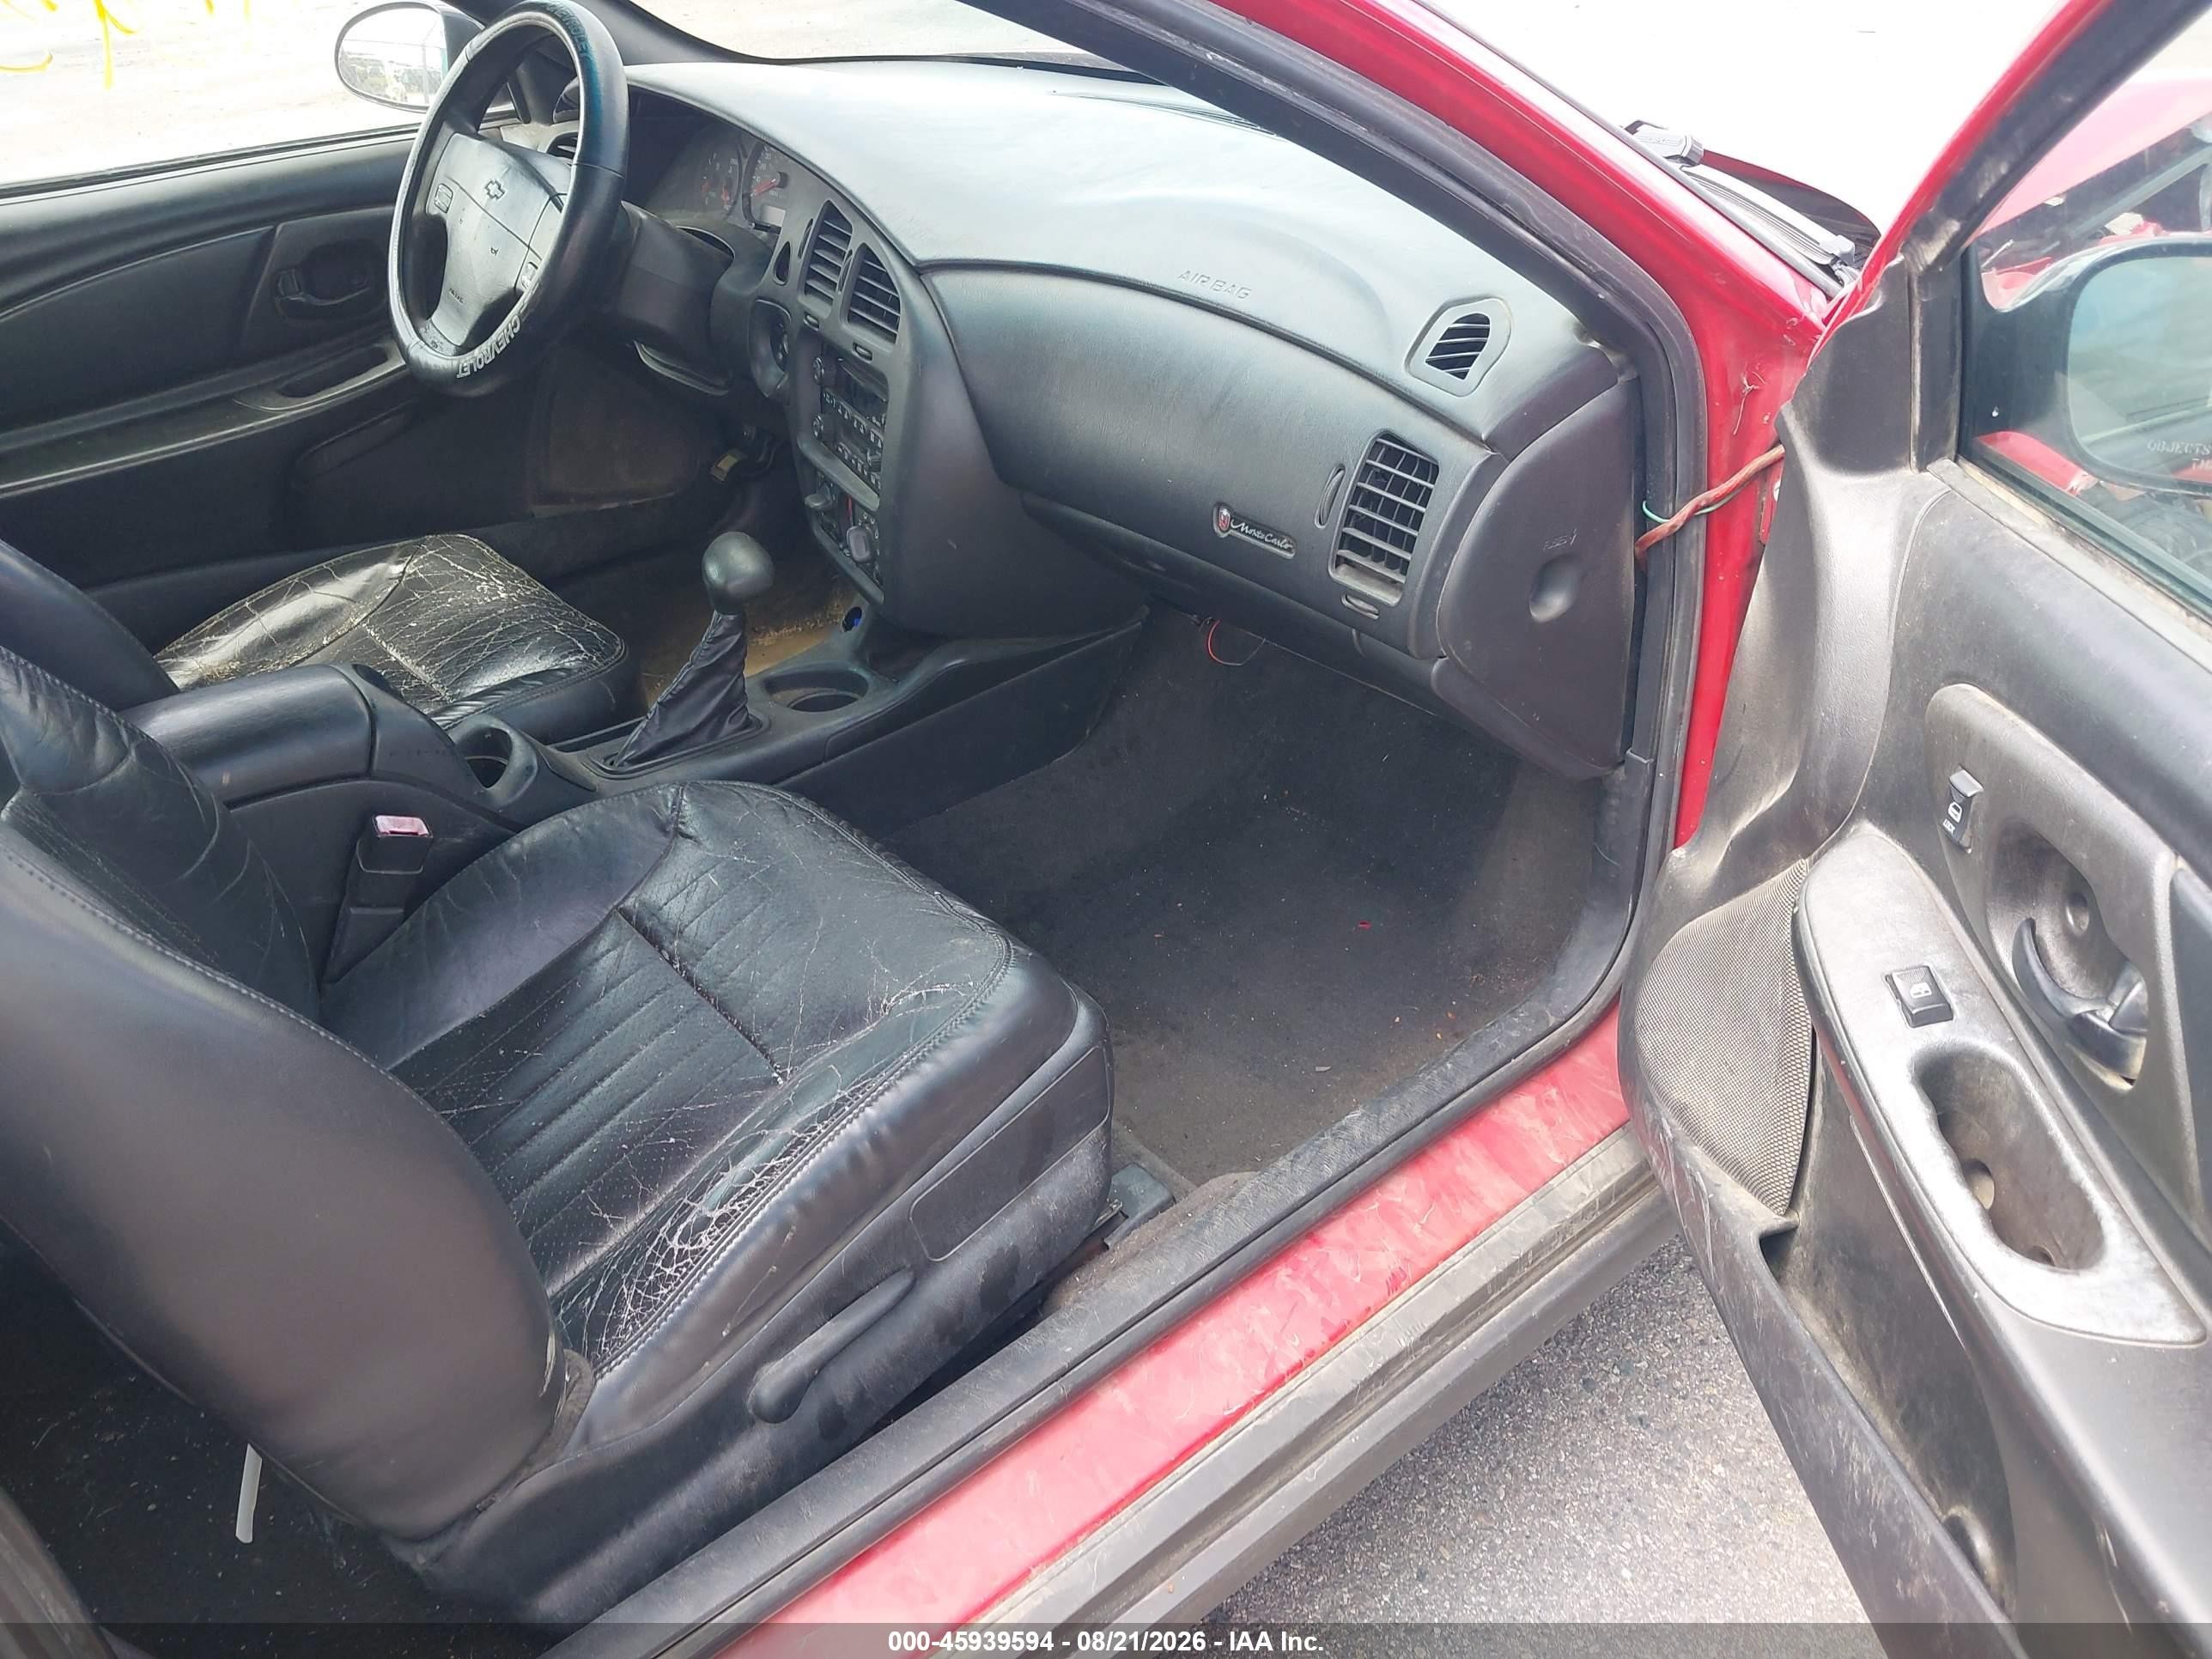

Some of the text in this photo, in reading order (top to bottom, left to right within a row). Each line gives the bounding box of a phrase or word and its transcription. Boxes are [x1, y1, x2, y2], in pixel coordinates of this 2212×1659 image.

[1176, 270, 1253, 300] AIRBAG
[456, 314, 521, 379] CHEVROLET
[2147, 439, 2210, 455] OBJECTS
